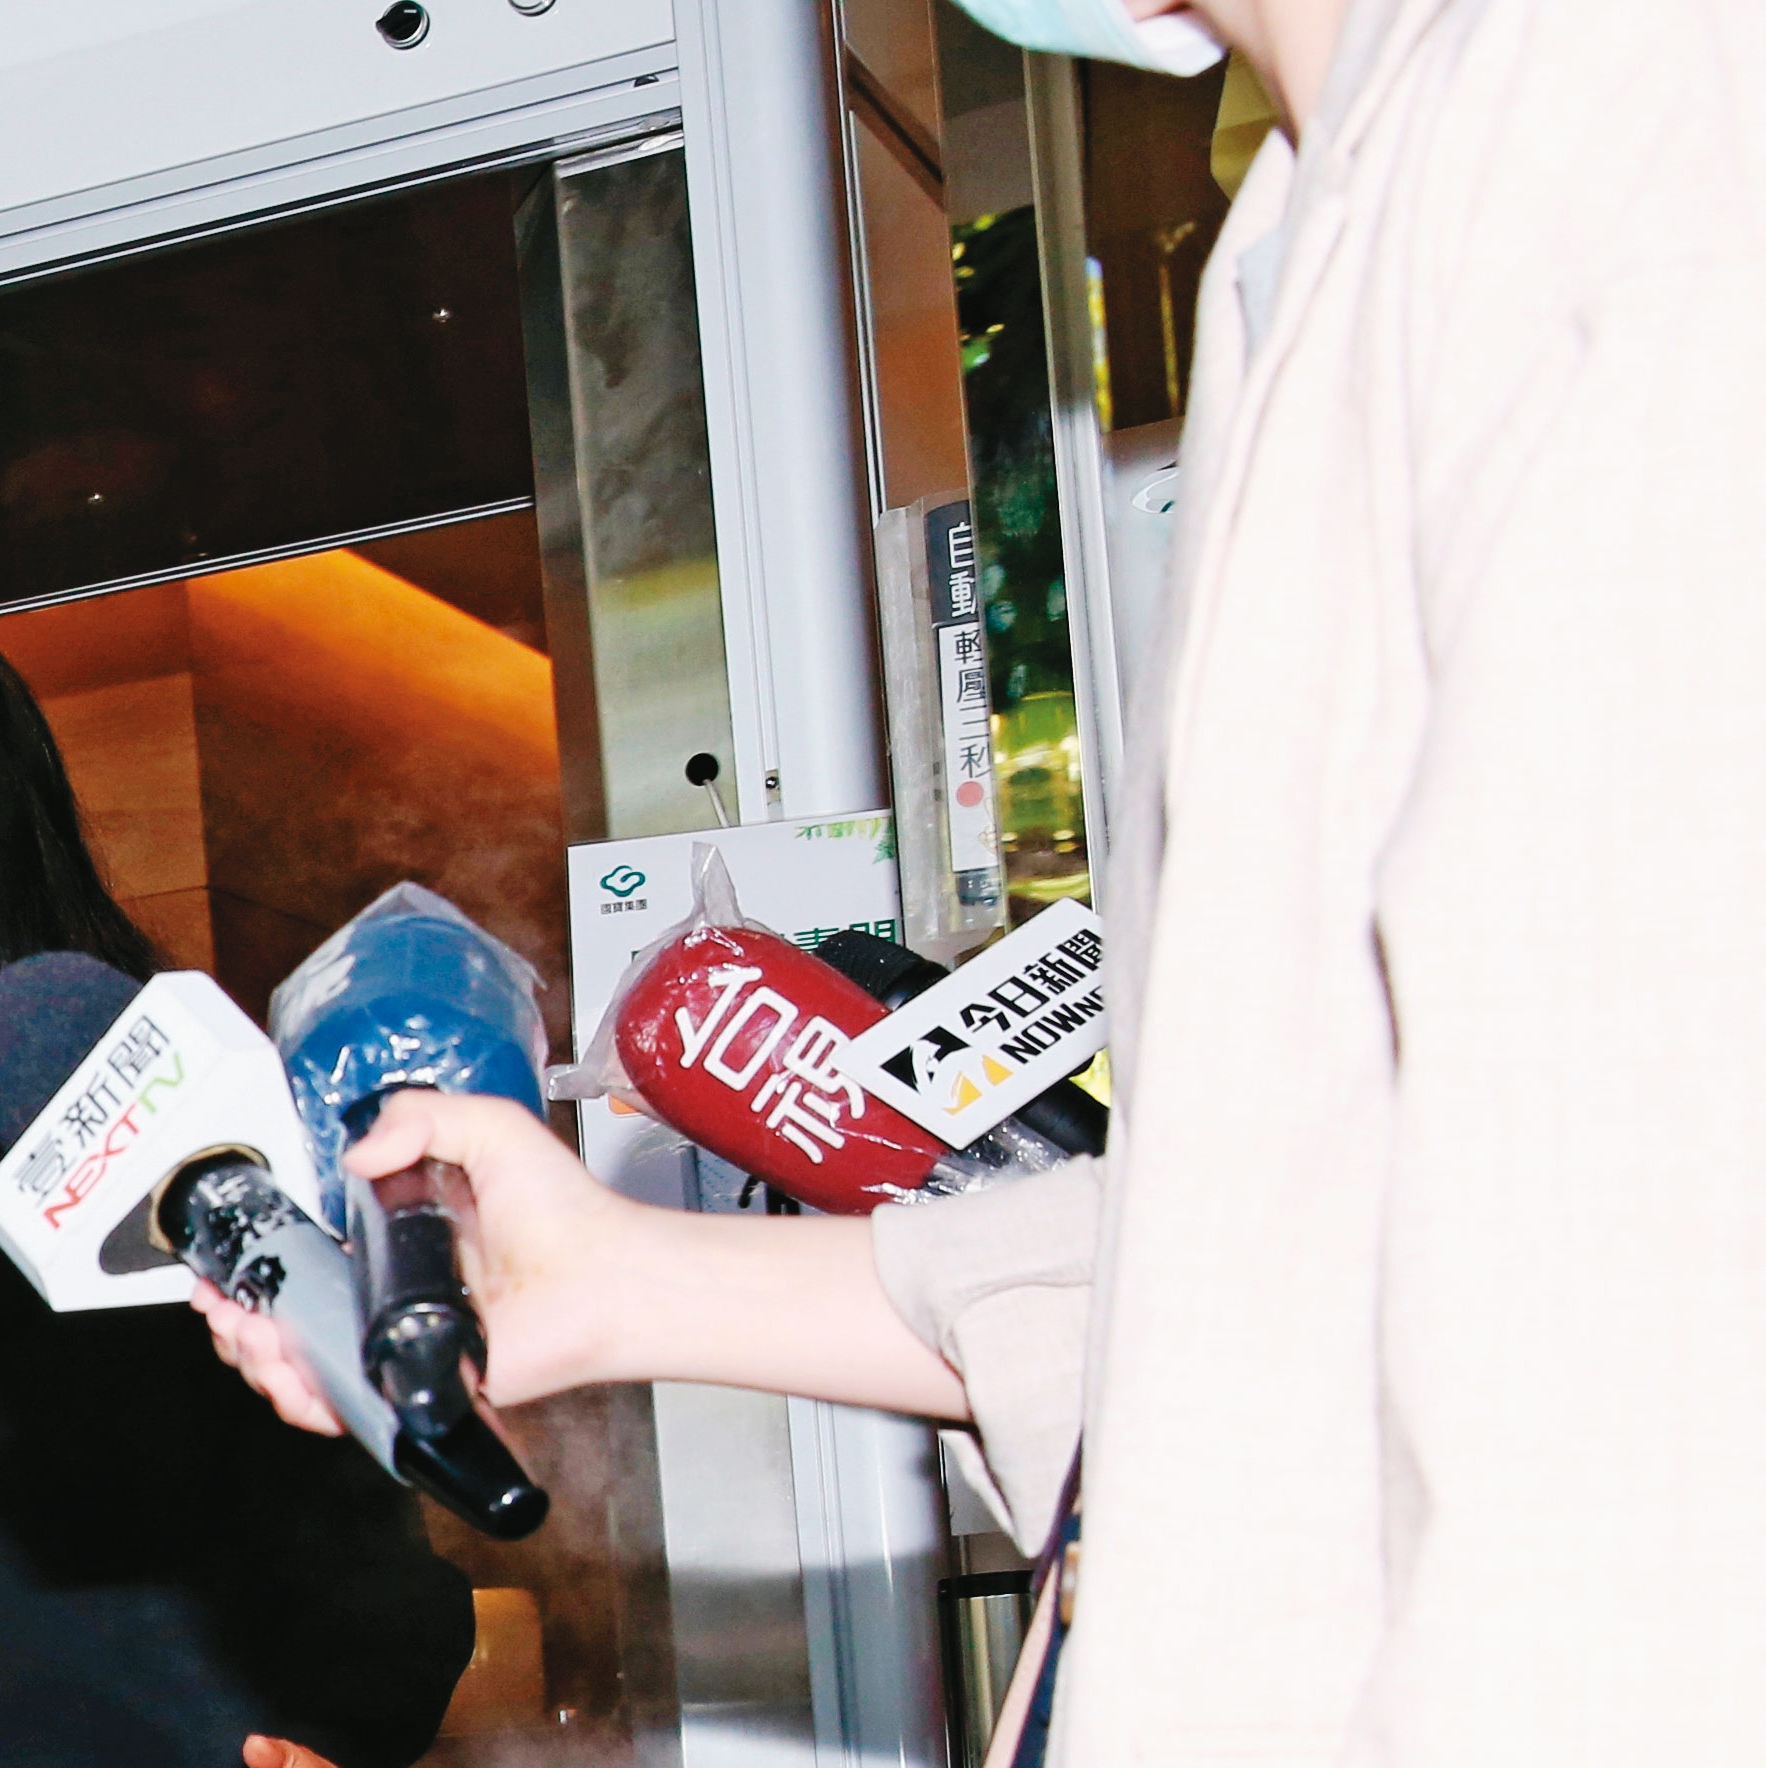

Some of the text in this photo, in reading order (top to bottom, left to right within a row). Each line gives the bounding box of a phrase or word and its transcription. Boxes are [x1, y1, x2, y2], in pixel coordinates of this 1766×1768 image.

[959, 928, 1104, 1034] 今日新聞
[998, 984, 1105, 1065] NOWN
[674, 962, 866, 1164] 台視
